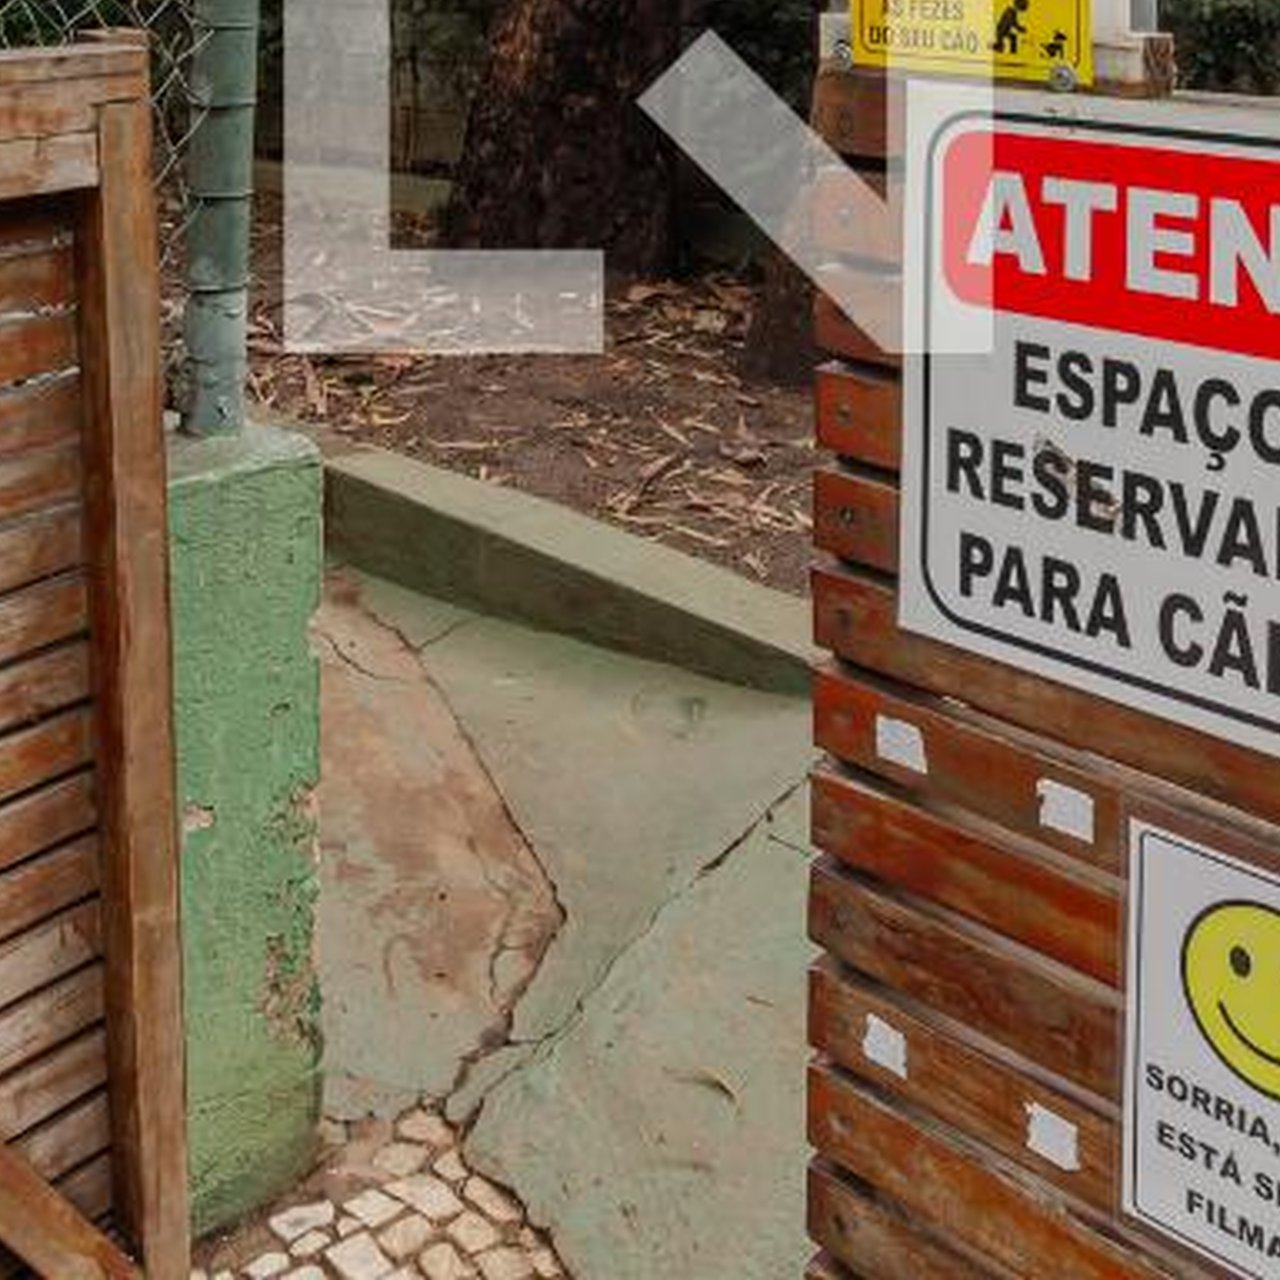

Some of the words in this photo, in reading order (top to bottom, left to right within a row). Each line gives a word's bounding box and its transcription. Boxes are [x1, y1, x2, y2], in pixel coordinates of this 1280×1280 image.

[869, 25, 893, 45] DO
[900, 27, 936, 49] SEU
[909, 0, 965, 21] FEZES
[958, 532, 1132, 649] PARA
[1146, 1064, 1280, 1156] SORRIA,
[1157, 1120, 1242, 1186] ESTÁ
